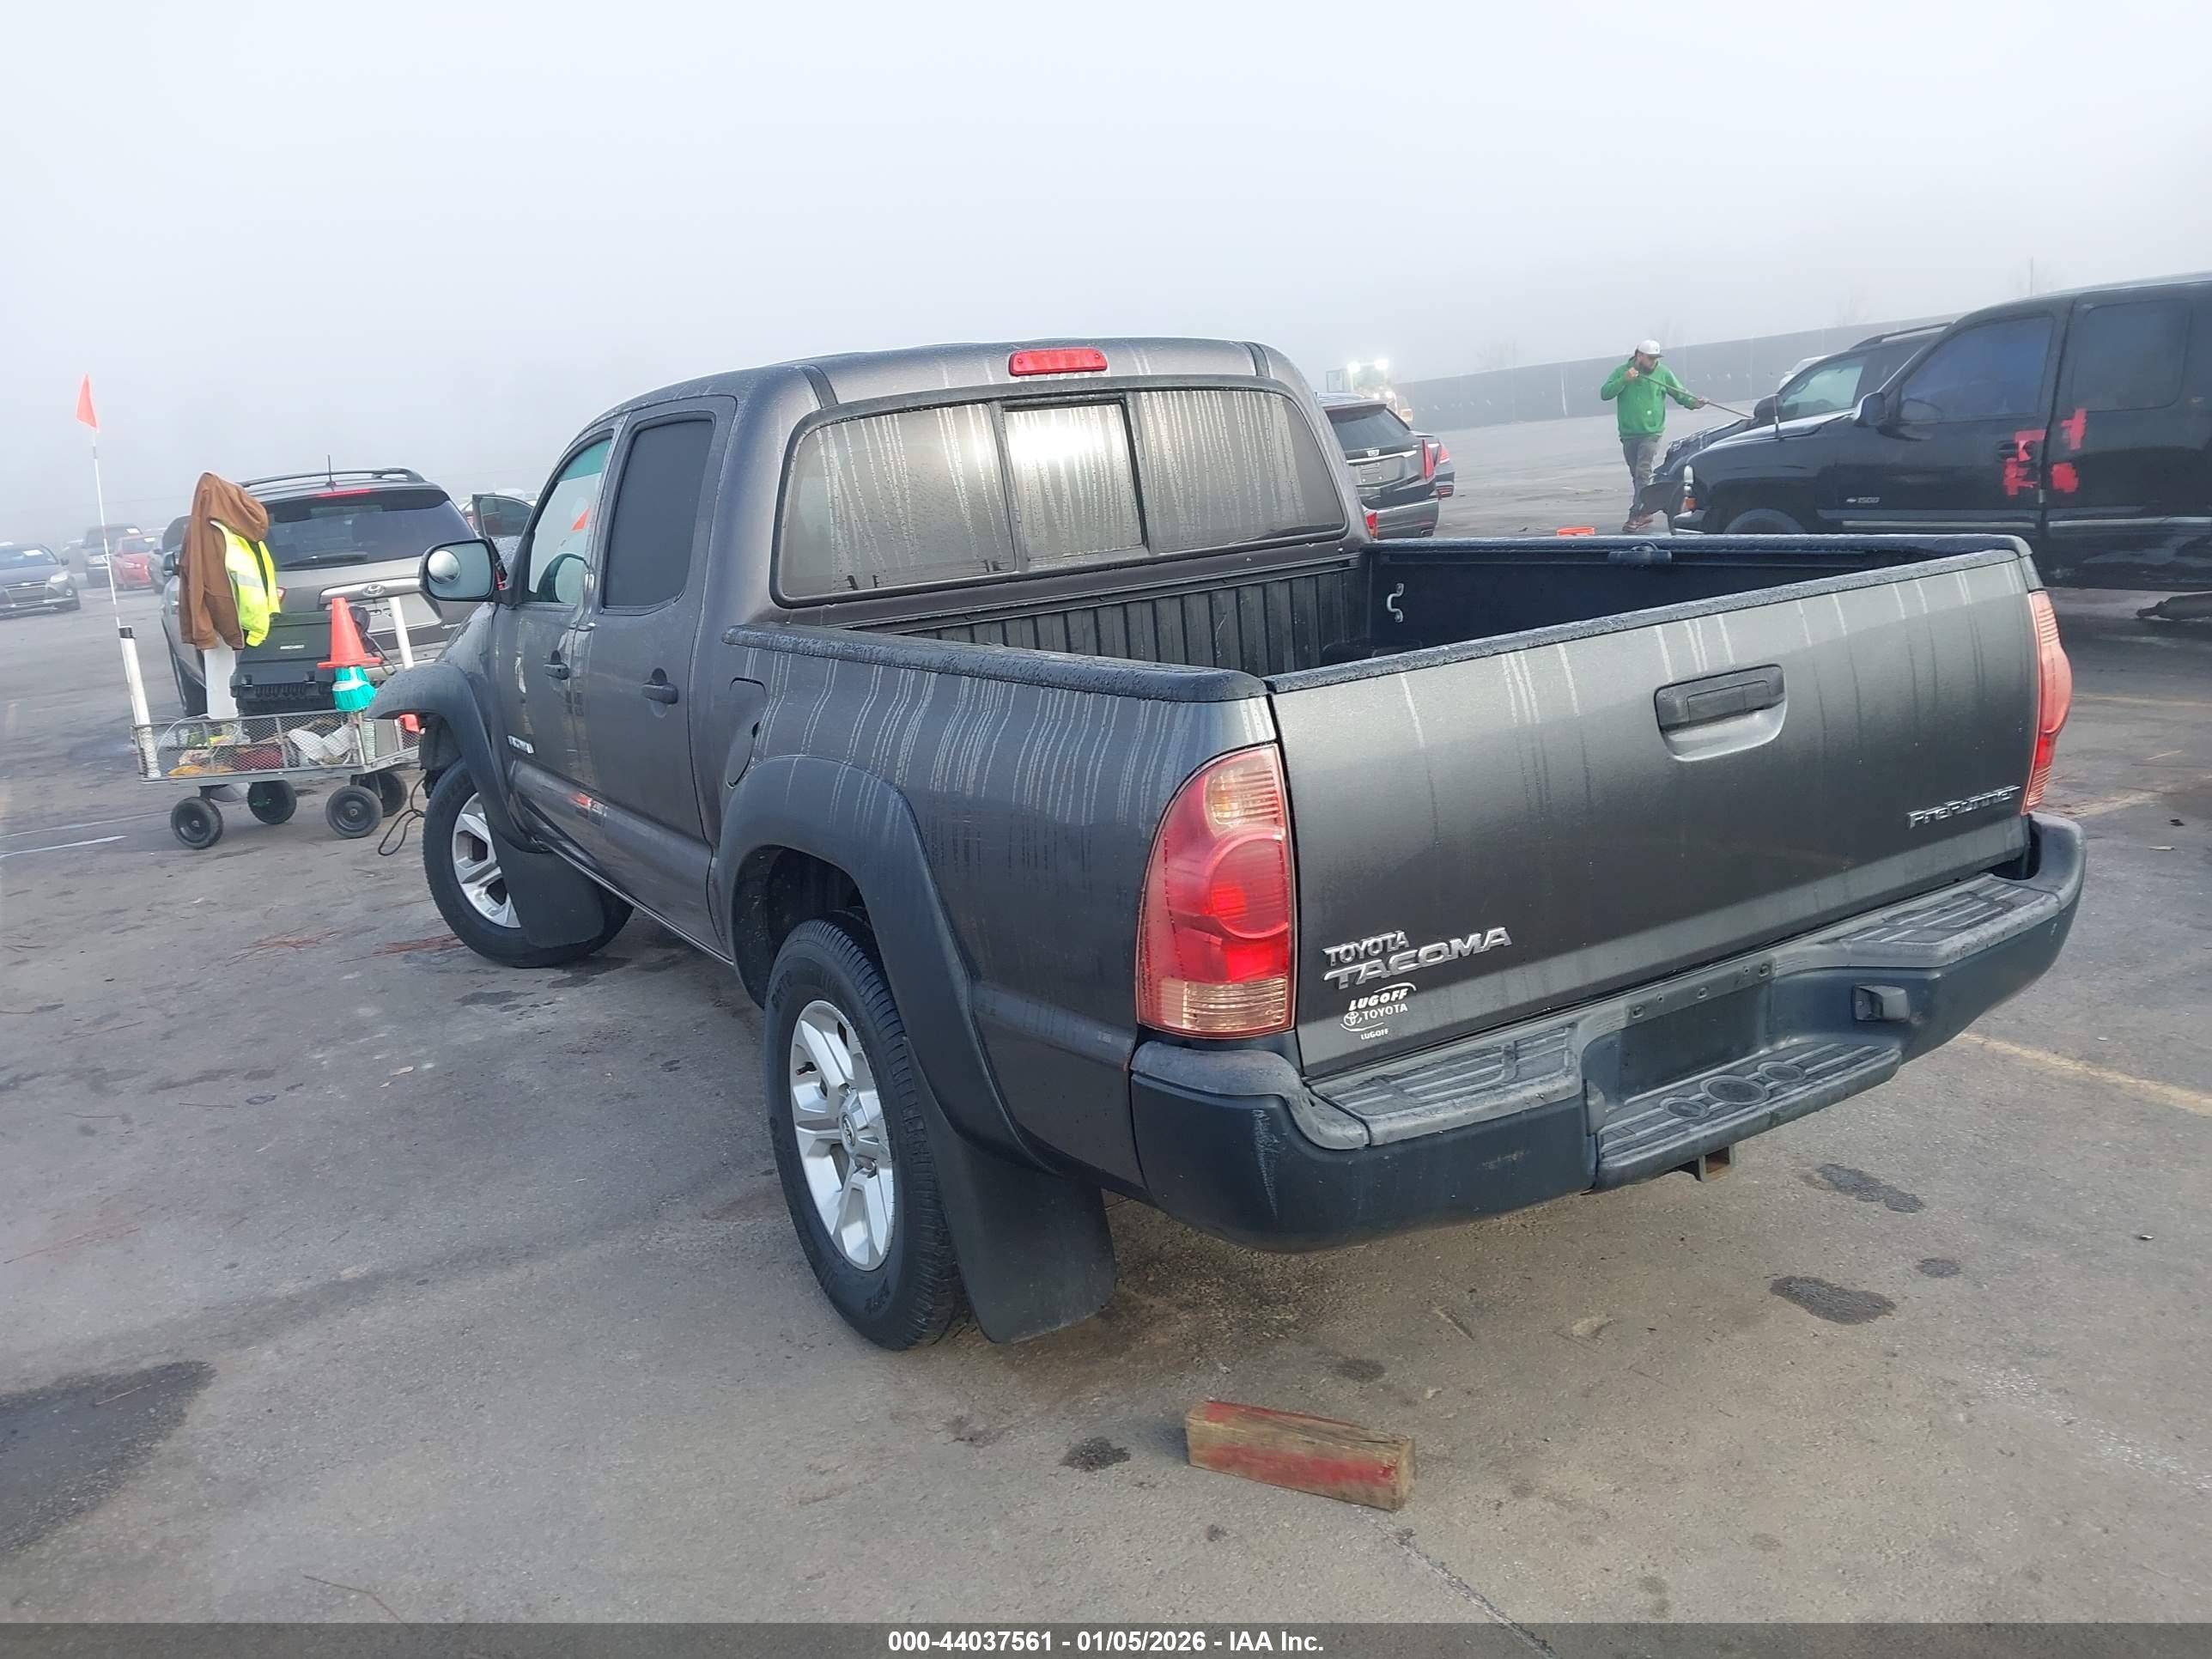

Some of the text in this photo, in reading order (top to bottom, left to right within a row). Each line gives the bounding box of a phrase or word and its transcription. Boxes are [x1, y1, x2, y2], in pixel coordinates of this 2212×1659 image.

[1322, 930, 1410, 967] TOYOTA
[1323, 926, 1513, 990] TACOMA
[1348, 988, 1409, 1012] LUGOFF
[1362, 1002, 1409, 1021] TOYOTA
[1360, 1028, 1389, 1041] LUGOFF
